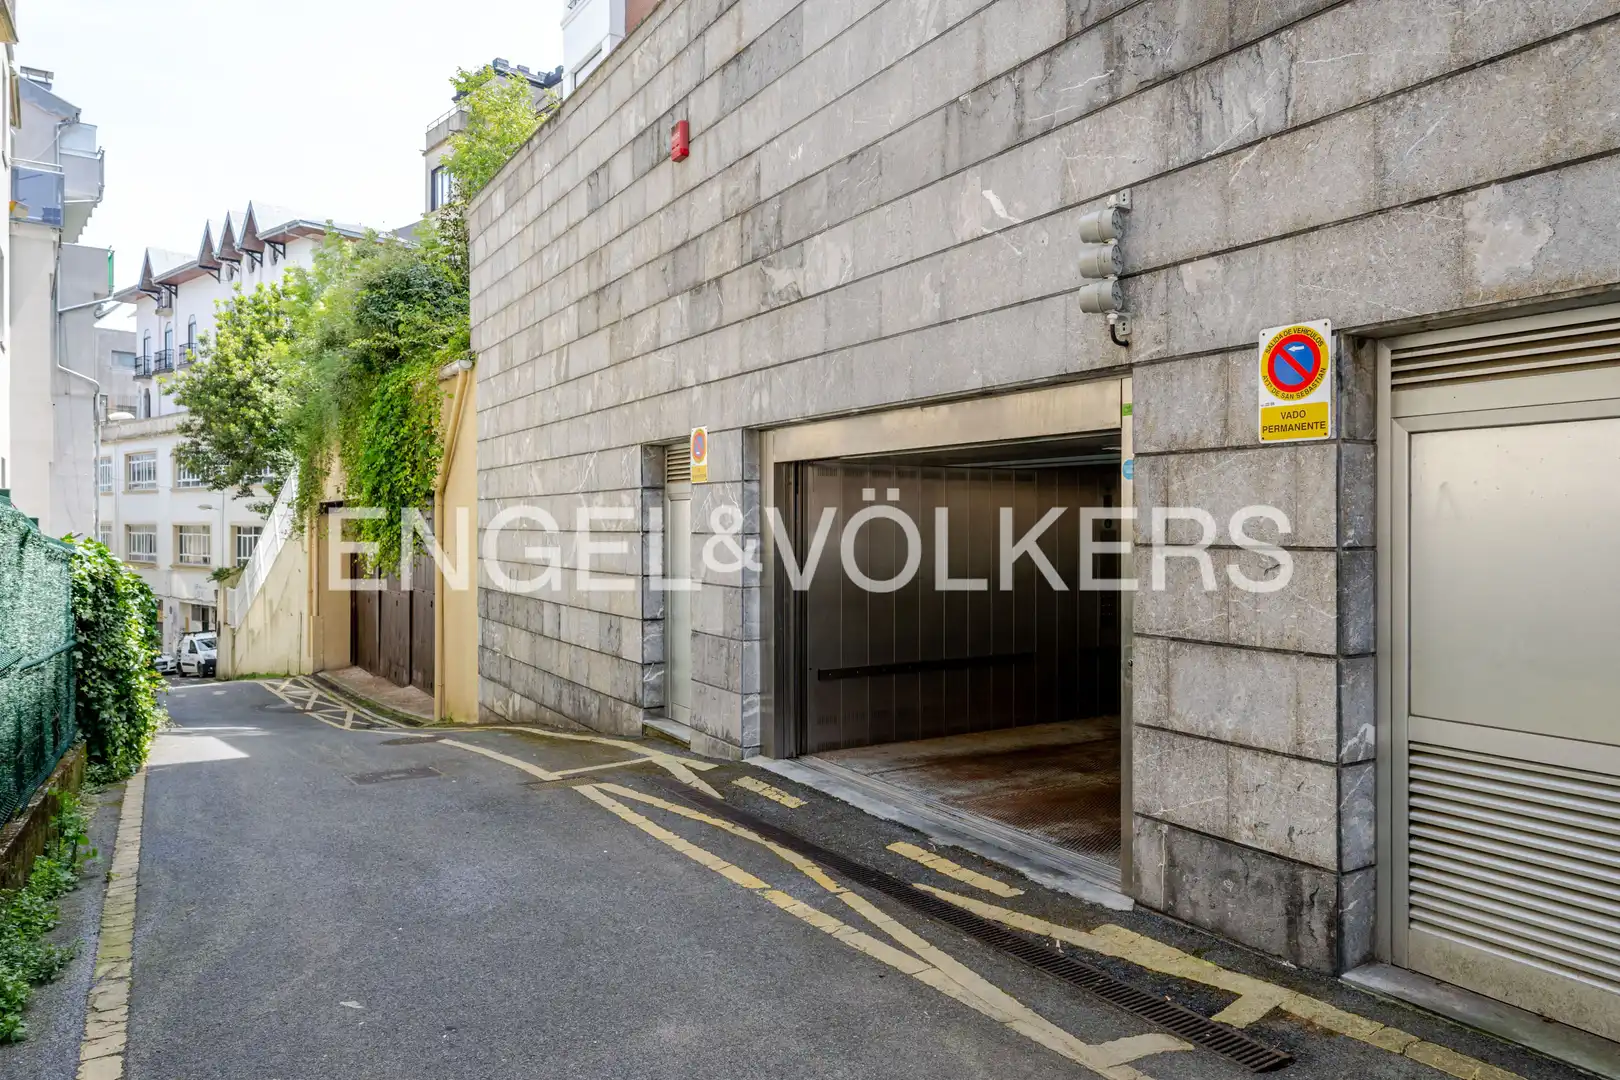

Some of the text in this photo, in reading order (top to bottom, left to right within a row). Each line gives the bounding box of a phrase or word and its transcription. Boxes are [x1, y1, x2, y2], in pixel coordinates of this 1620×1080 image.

[1264, 327, 1324, 354] SALIDA DE VEHICULOS
[1271, 387, 1280, 397] DE
[1280, 392, 1294, 400] SAN
[1296, 367, 1327, 399] SEBASTIAN
[1280, 409, 1307, 420] VADO
[1262, 420, 1327, 434] PERMANENTE
